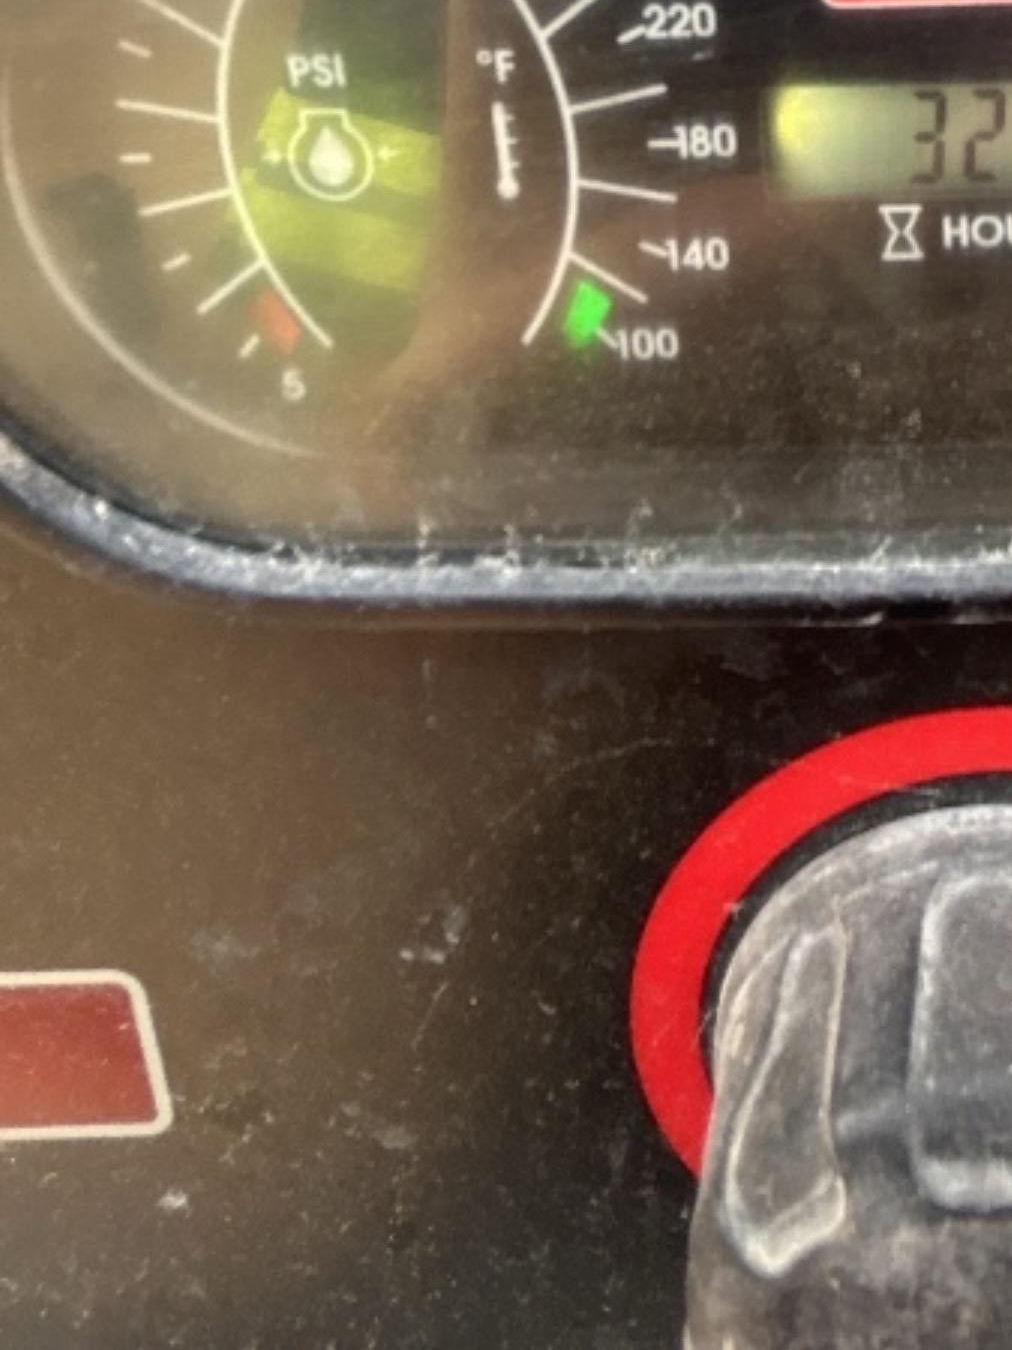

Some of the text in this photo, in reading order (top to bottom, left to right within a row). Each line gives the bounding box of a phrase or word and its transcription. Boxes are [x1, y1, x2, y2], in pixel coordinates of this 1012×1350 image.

[643, 2, 717, 39] 220
[286, 52, 347, 88] PSI
[674, 124, 738, 158] 180
[665, 237, 730, 271] 140
[615, 329, 679, 361] 100
[281, 368, 307, 402] 5
